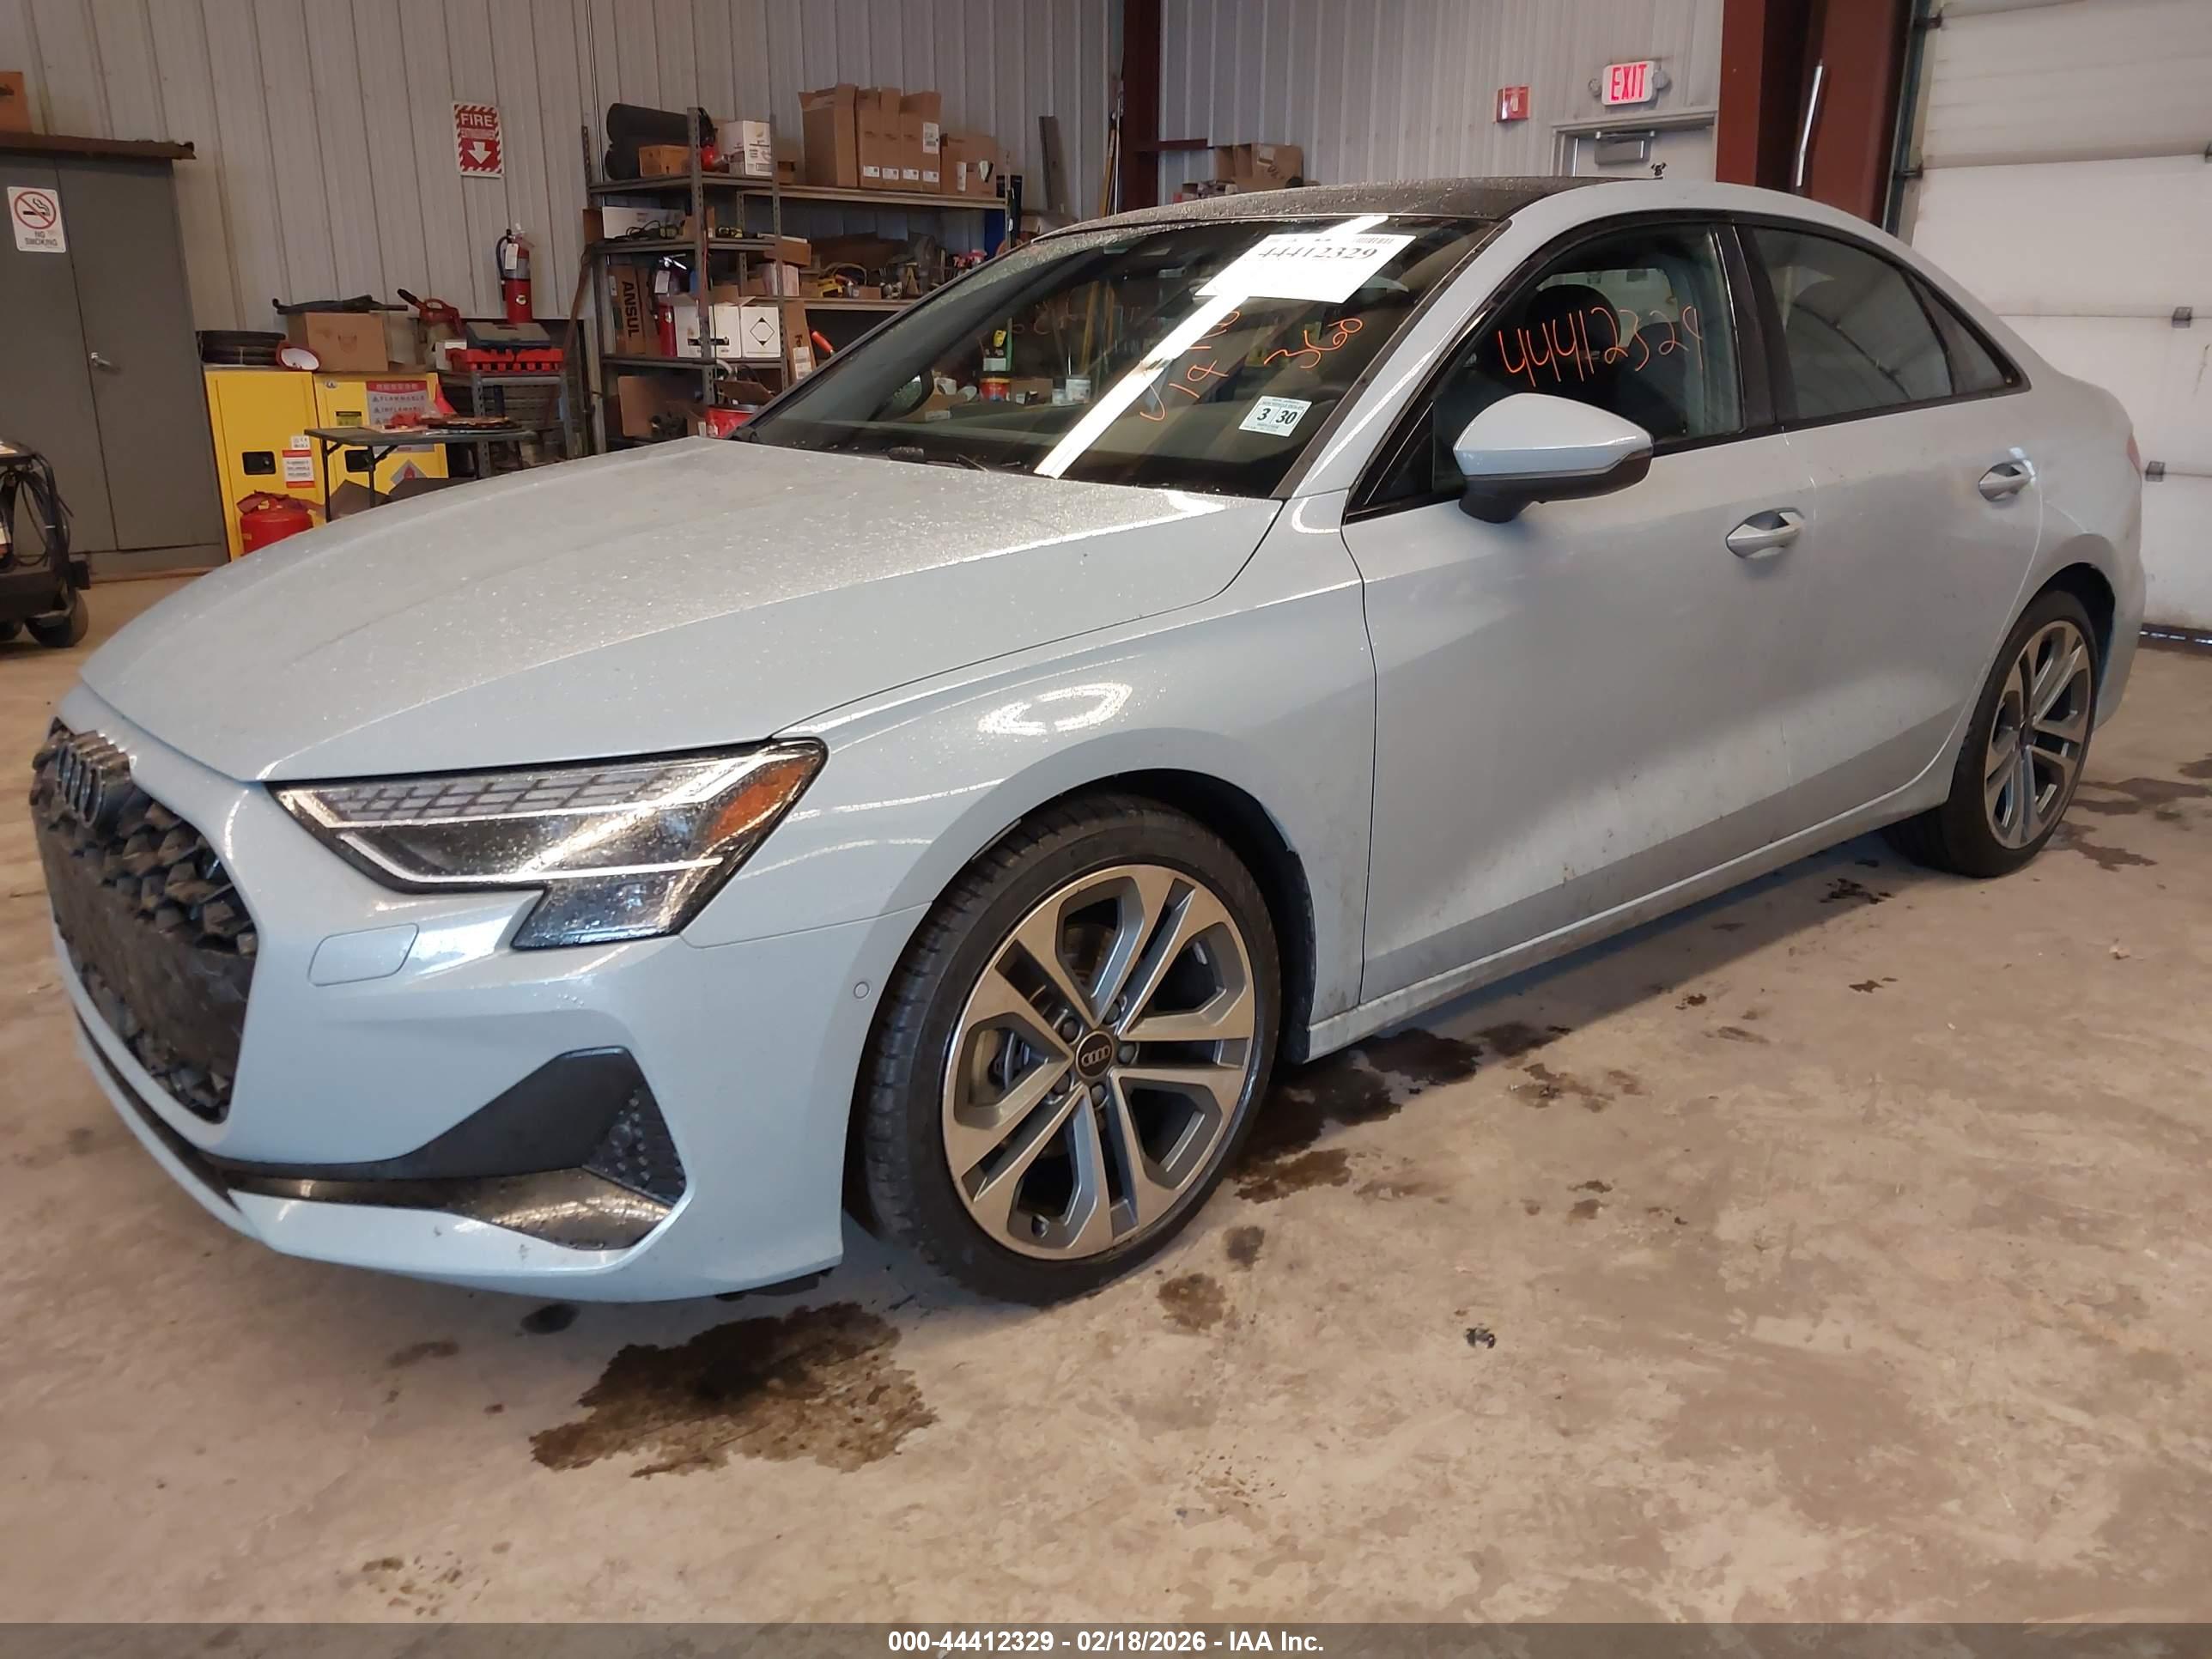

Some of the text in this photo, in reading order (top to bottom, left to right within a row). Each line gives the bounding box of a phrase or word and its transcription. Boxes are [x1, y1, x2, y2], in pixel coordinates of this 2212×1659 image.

[1610, 63, 1647, 101] EXIT
[459, 112, 494, 127] FIRE
[1257, 246, 1378, 259] 44412329
[622, 281, 640, 337] ANSUL
[1498, 305, 1704, 387] 44412329
[1256, 407, 1298, 425] 3 30
